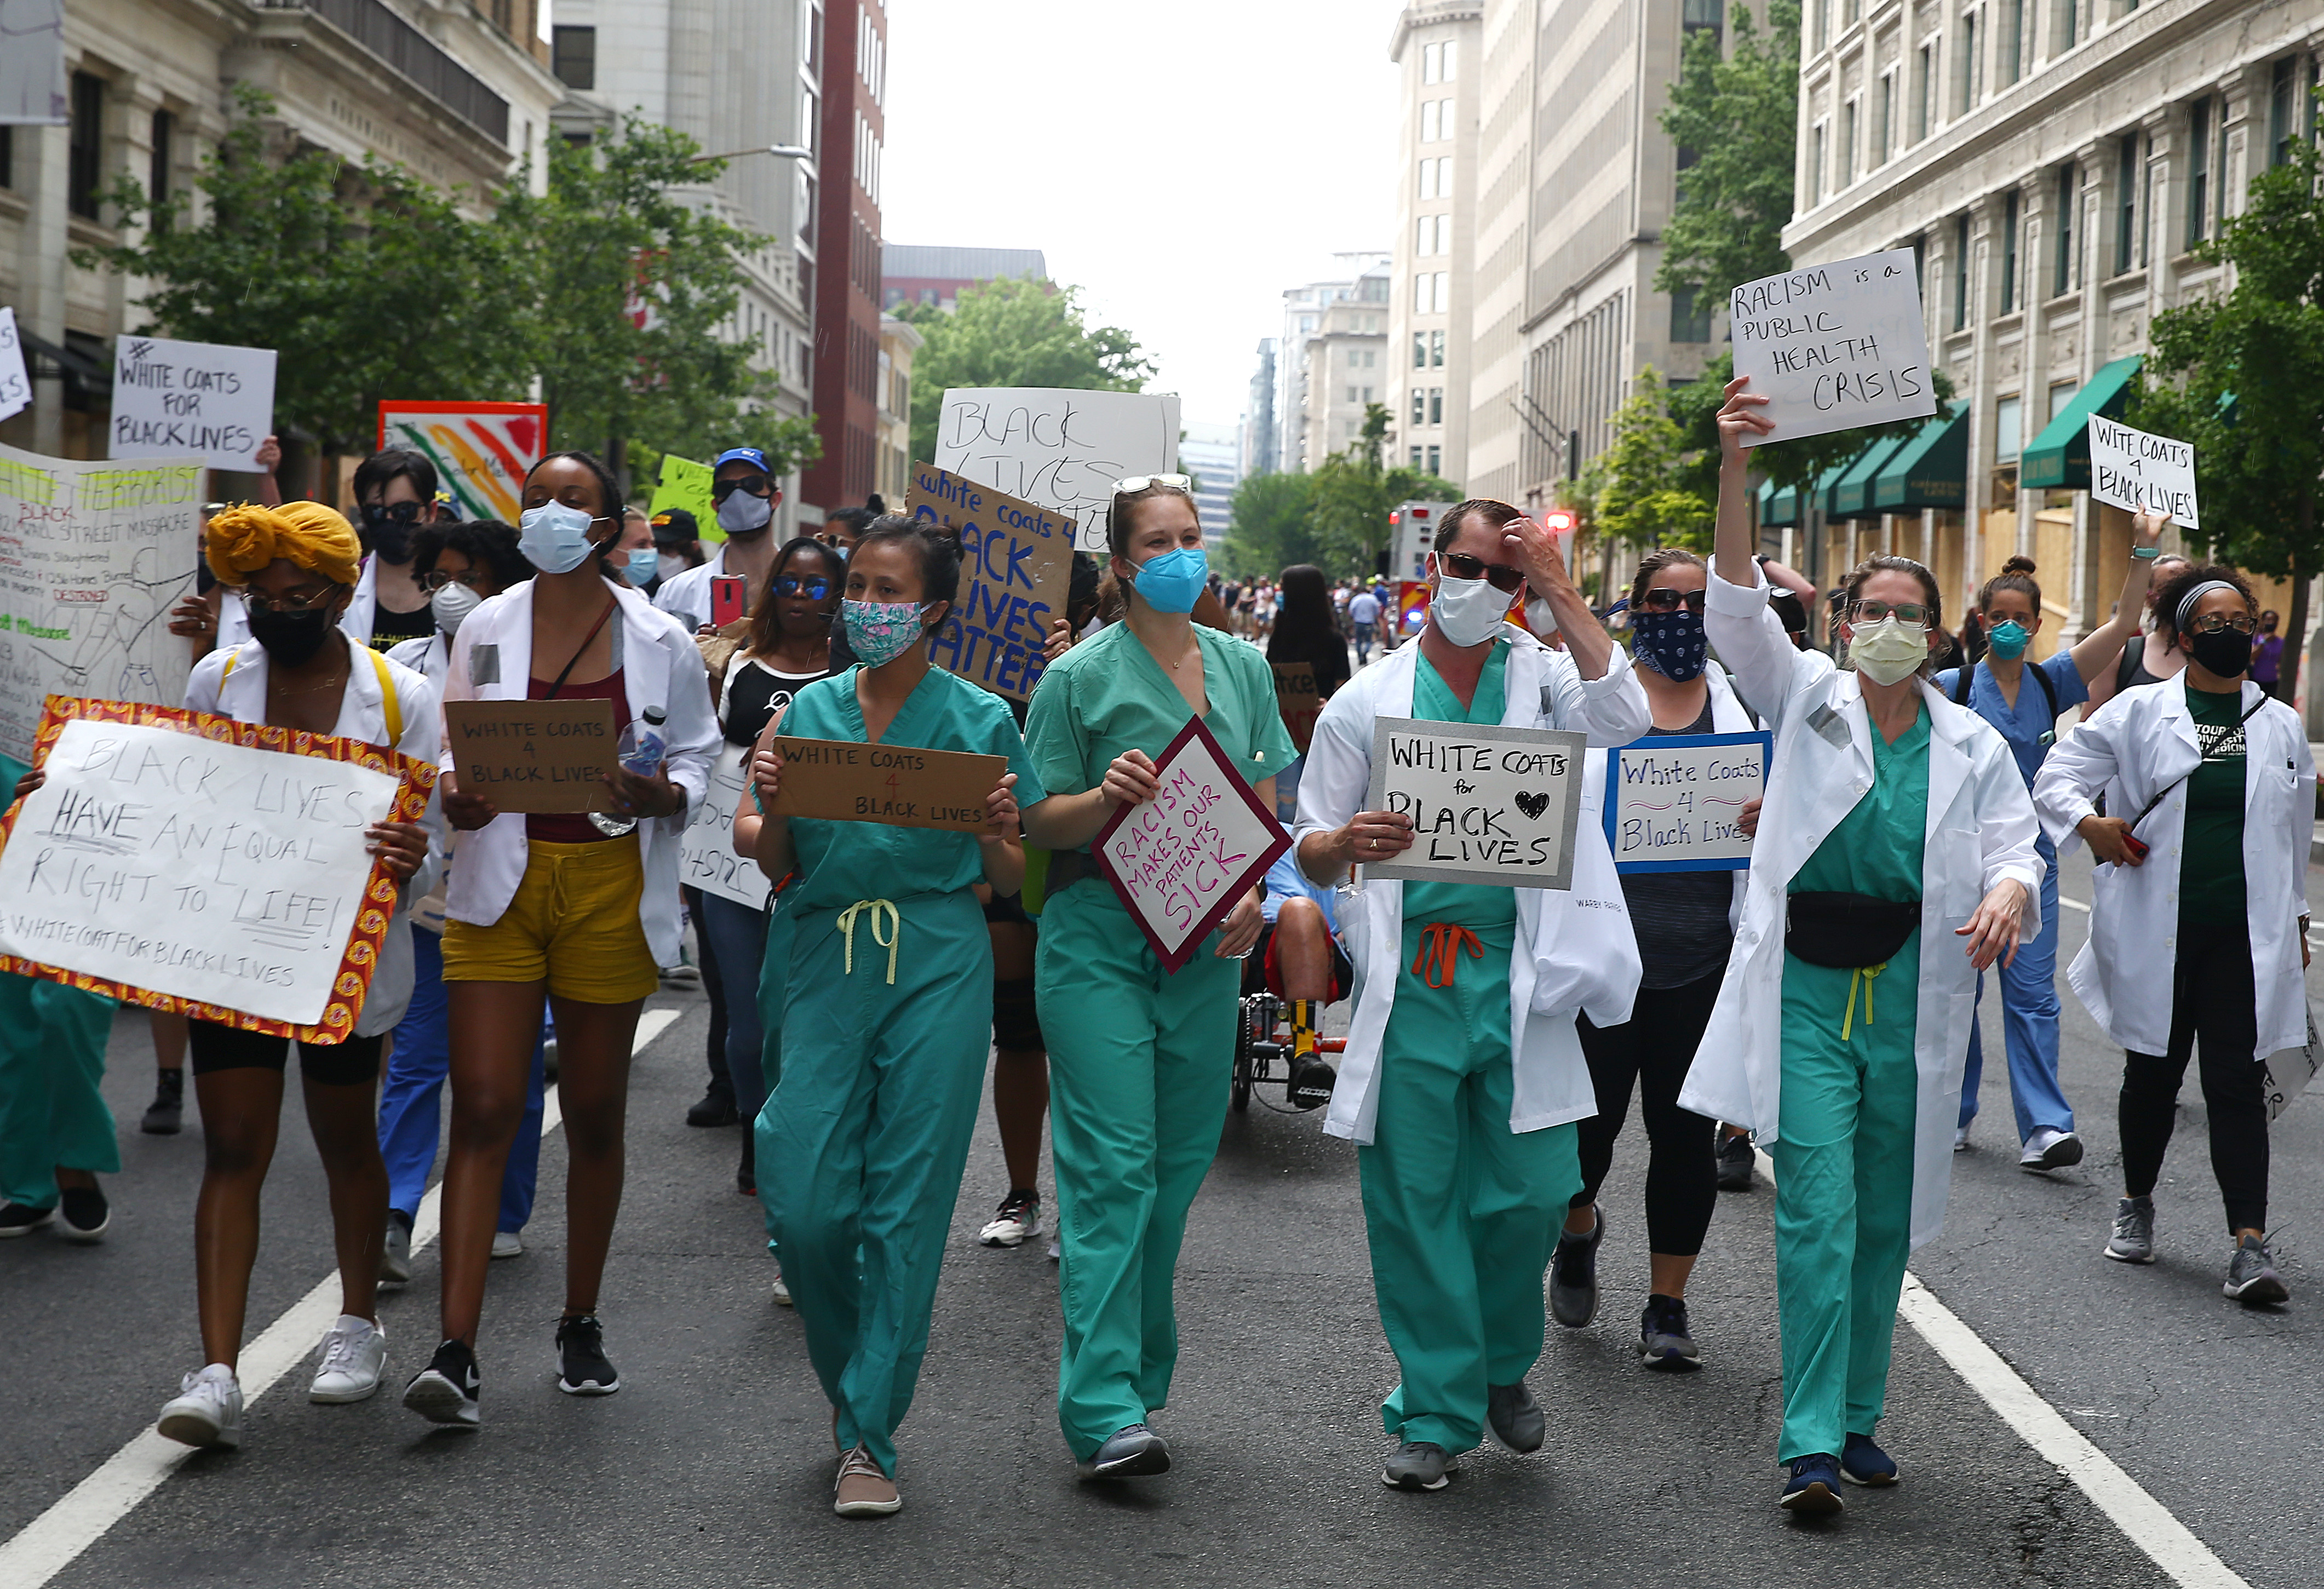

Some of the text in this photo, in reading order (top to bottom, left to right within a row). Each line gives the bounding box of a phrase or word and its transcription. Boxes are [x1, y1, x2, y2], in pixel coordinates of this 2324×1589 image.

[1735, 266, 1901, 319] RACISM is a
[1741, 312, 1843, 341] PUBLIC
[1772, 335, 1879, 375] HEALTH
[119, 358, 242, 394] WHITE COATS
[1814, 366, 1921, 411] CRISIS
[163, 394, 202, 417] FOR
[946, 401, 1096, 449] BLACK
[116, 415, 254, 454] BLACK LIVES
[2095, 420, 2188, 468] WITE COATS
[76, 466, 204, 511] TERRORIST
[2099, 466, 2144, 506] BLACK
[2150, 483, 2193, 520] LIVES
[19, 503, 77, 523] BLACK
[60, 523, 122, 543] STREET
[128, 513, 190, 540] MASSACRE
[913, 470, 1077, 548] white coats 4
[915, 504, 1034, 590] ACK
[954, 579, 1051, 651] IVES
[927, 617, 1047, 695] ATTER
[1275, 667, 1315, 694] tice
[462, 722, 604, 739] WHITE COATS
[523, 741, 536, 759] 4
[472, 765, 605, 783] BLACK LIVES
[781, 744, 925, 771] WHITE COATS
[1390, 737, 1569, 776] WHITE COATS
[1621, 757, 1760, 785] White Coats
[80, 737, 365, 829] BLACK LIVES
[885, 773, 900, 799] 4
[1453, 778, 1476, 795] for
[1677, 790, 1694, 813] 4
[855, 796, 983, 822] BLACK LIVES
[1115, 767, 1197, 868] RACISM
[1387, 790, 1512, 838] BLACK
[50, 788, 329, 886] HAVE AN EQUAL
[1127, 784, 1221, 898] MAKES OUR
[1428, 836, 1551, 865] LIVES
[1622, 818, 1691, 852] Black
[1155, 820, 1220, 897] PATIENTS
[27, 847, 342, 950] RIGHT TO LIFE!
[1164, 837, 1248, 931] SICK
